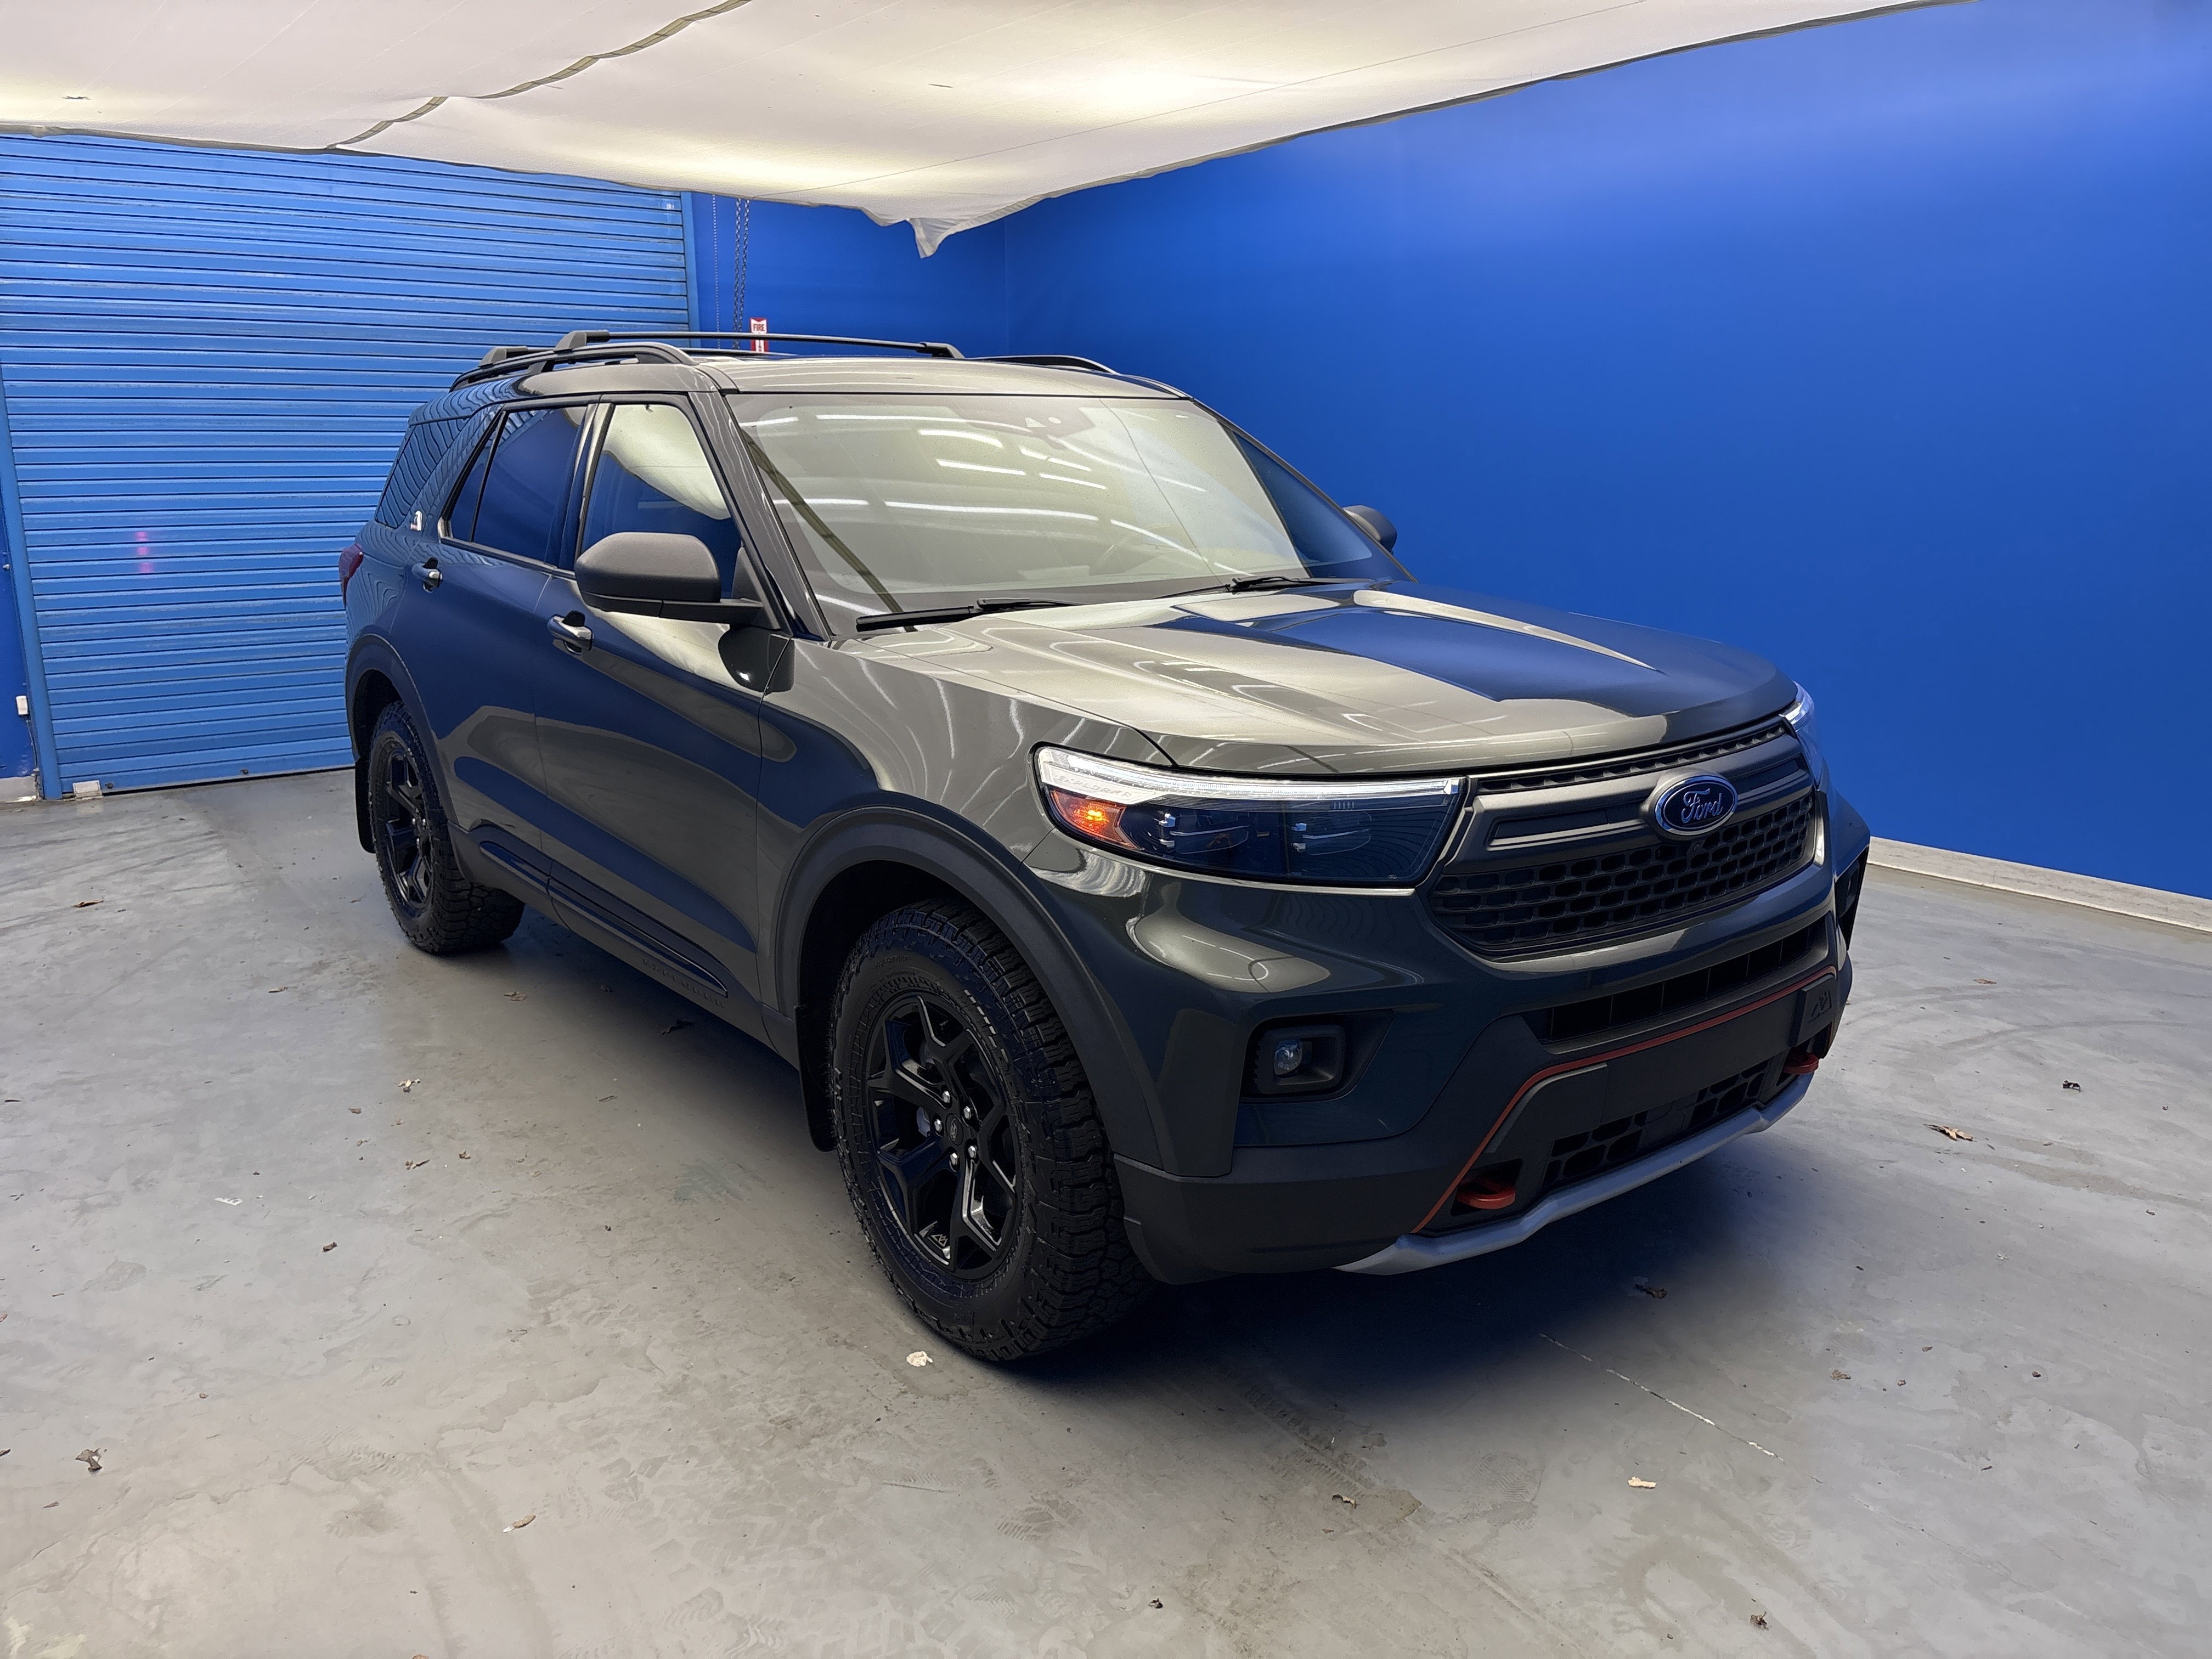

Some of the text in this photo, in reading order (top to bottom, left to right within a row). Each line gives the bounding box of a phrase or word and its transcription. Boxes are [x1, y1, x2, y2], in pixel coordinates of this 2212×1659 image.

[753, 323, 765, 331] FIRE
[1054, 774, 1132, 798] EXPLORER
[1681, 788, 1723, 823] Ford
